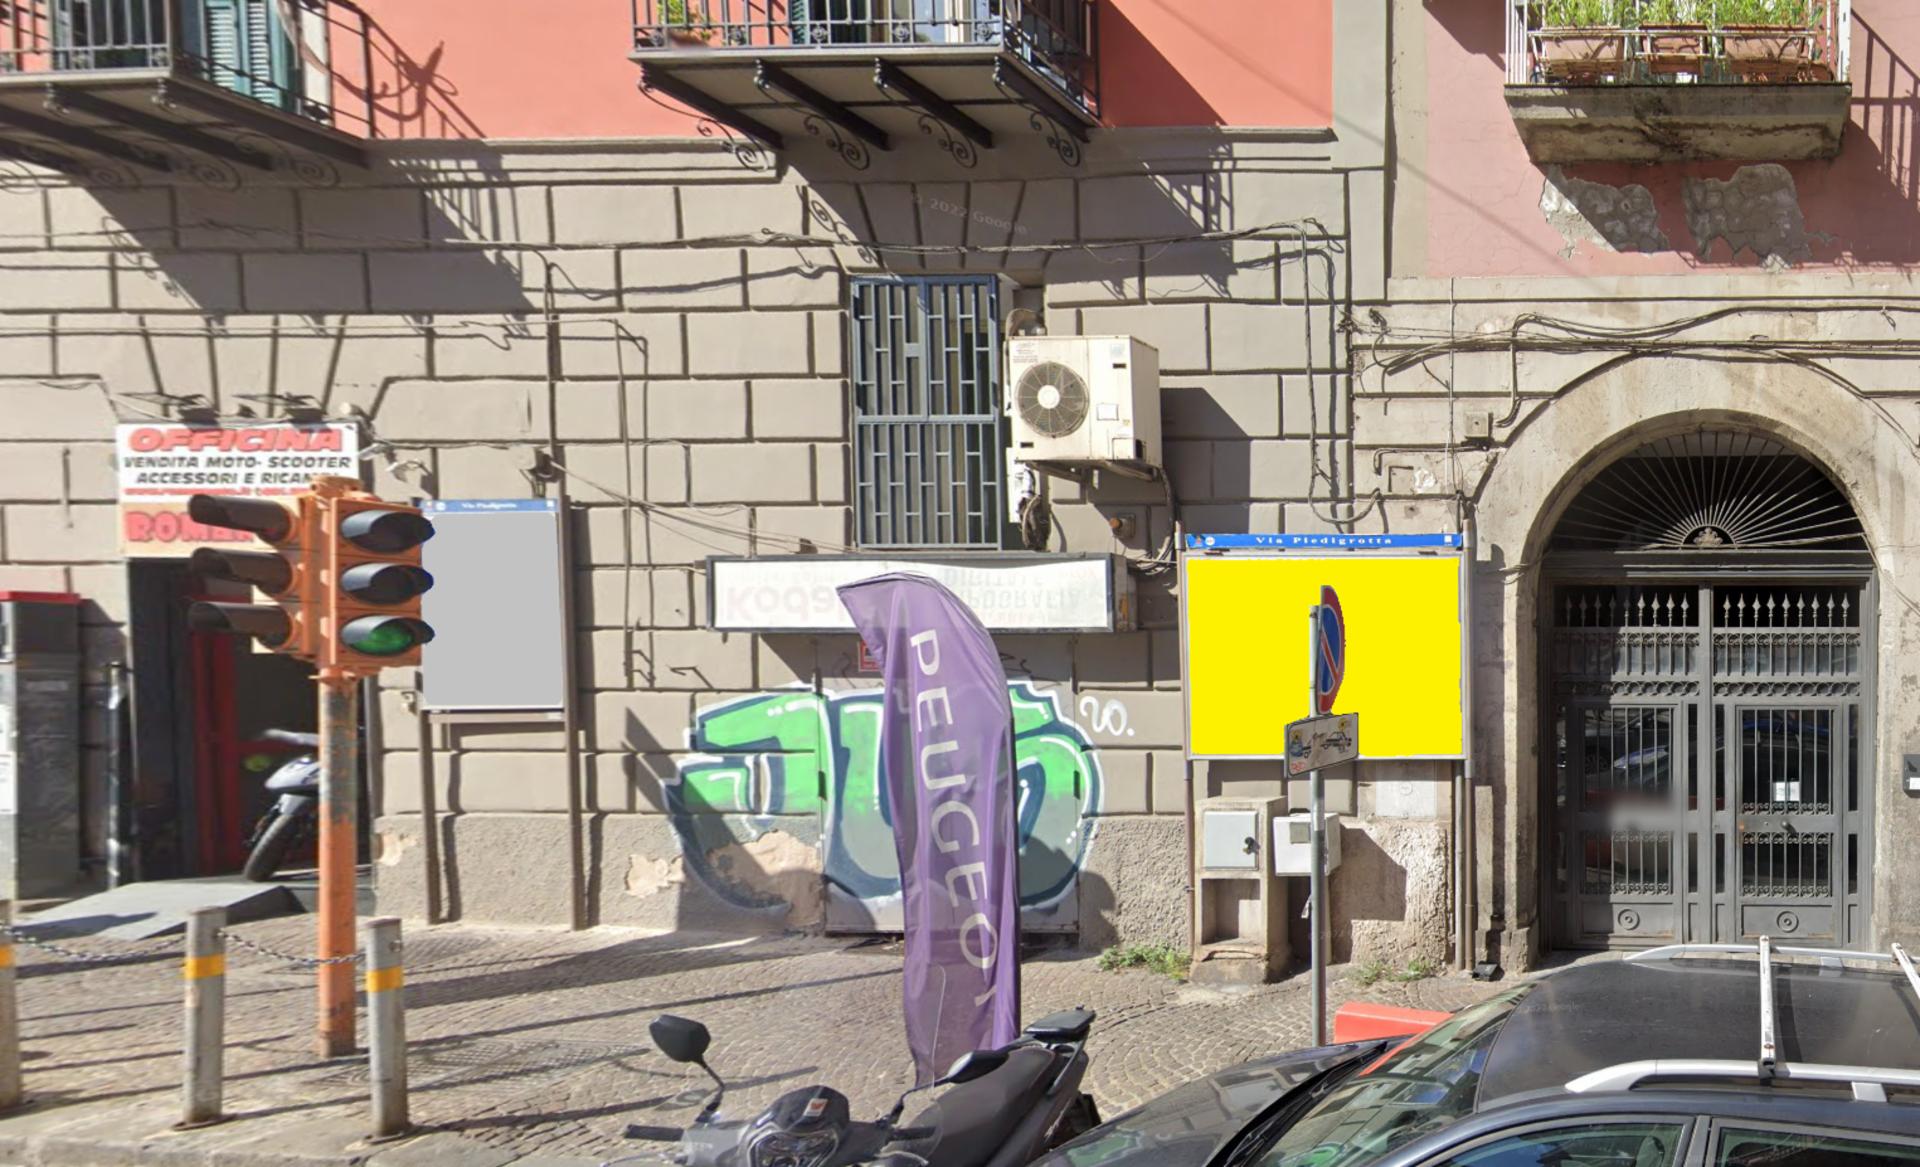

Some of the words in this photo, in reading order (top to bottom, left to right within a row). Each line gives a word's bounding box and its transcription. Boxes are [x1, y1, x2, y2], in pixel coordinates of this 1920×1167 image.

[130, 428, 342, 452] OFFICINA
[124, 457, 199, 468] VENDITA
[268, 457, 351, 469] SCOOTER
[136, 472, 238, 484] ACCESSORI
[244, 472, 254, 484] E
[261, 472, 339, 484] RICA
[1293, 537, 1392, 545] Piedigrotta
